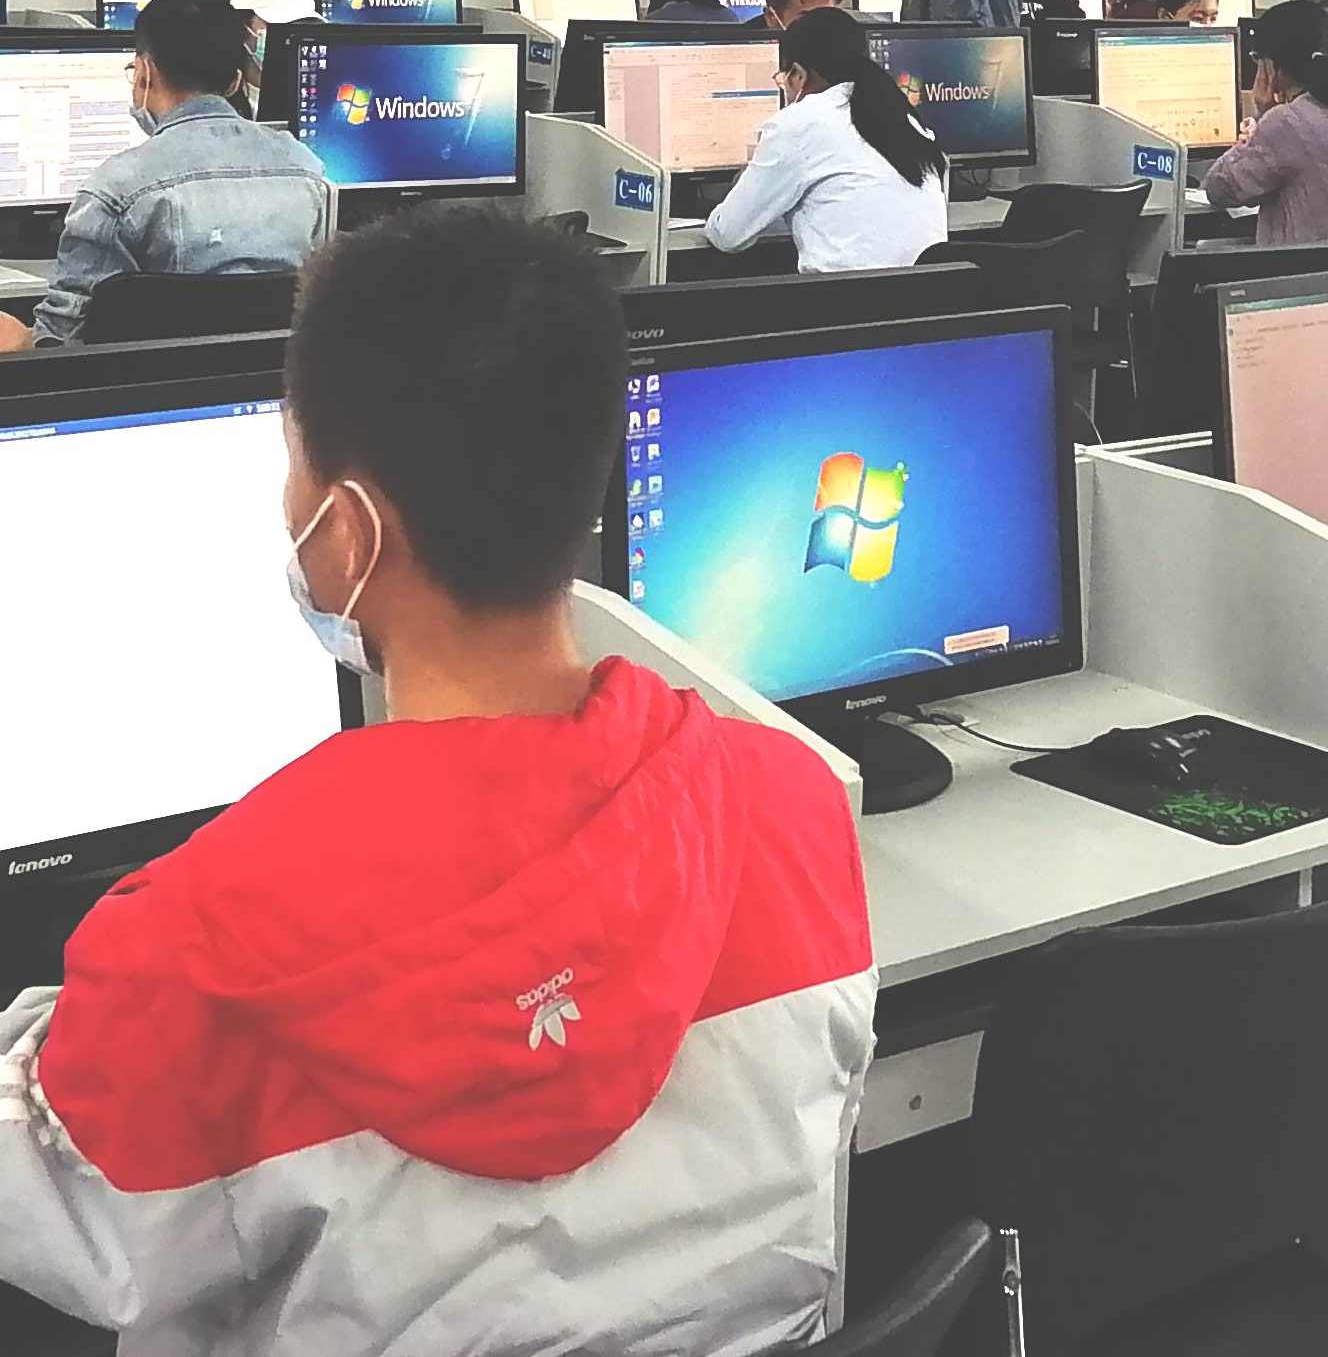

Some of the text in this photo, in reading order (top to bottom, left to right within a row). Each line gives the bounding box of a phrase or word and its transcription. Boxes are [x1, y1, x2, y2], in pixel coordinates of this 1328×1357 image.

[925, 82, 991, 102] Windows
[376, 95, 465, 119] Windows
[1137, 152, 1173, 174] C-08
[619, 178, 653, 203] C-06
[8, 853, 73, 875] lenovo
[516, 967, 574, 1010] adidas
